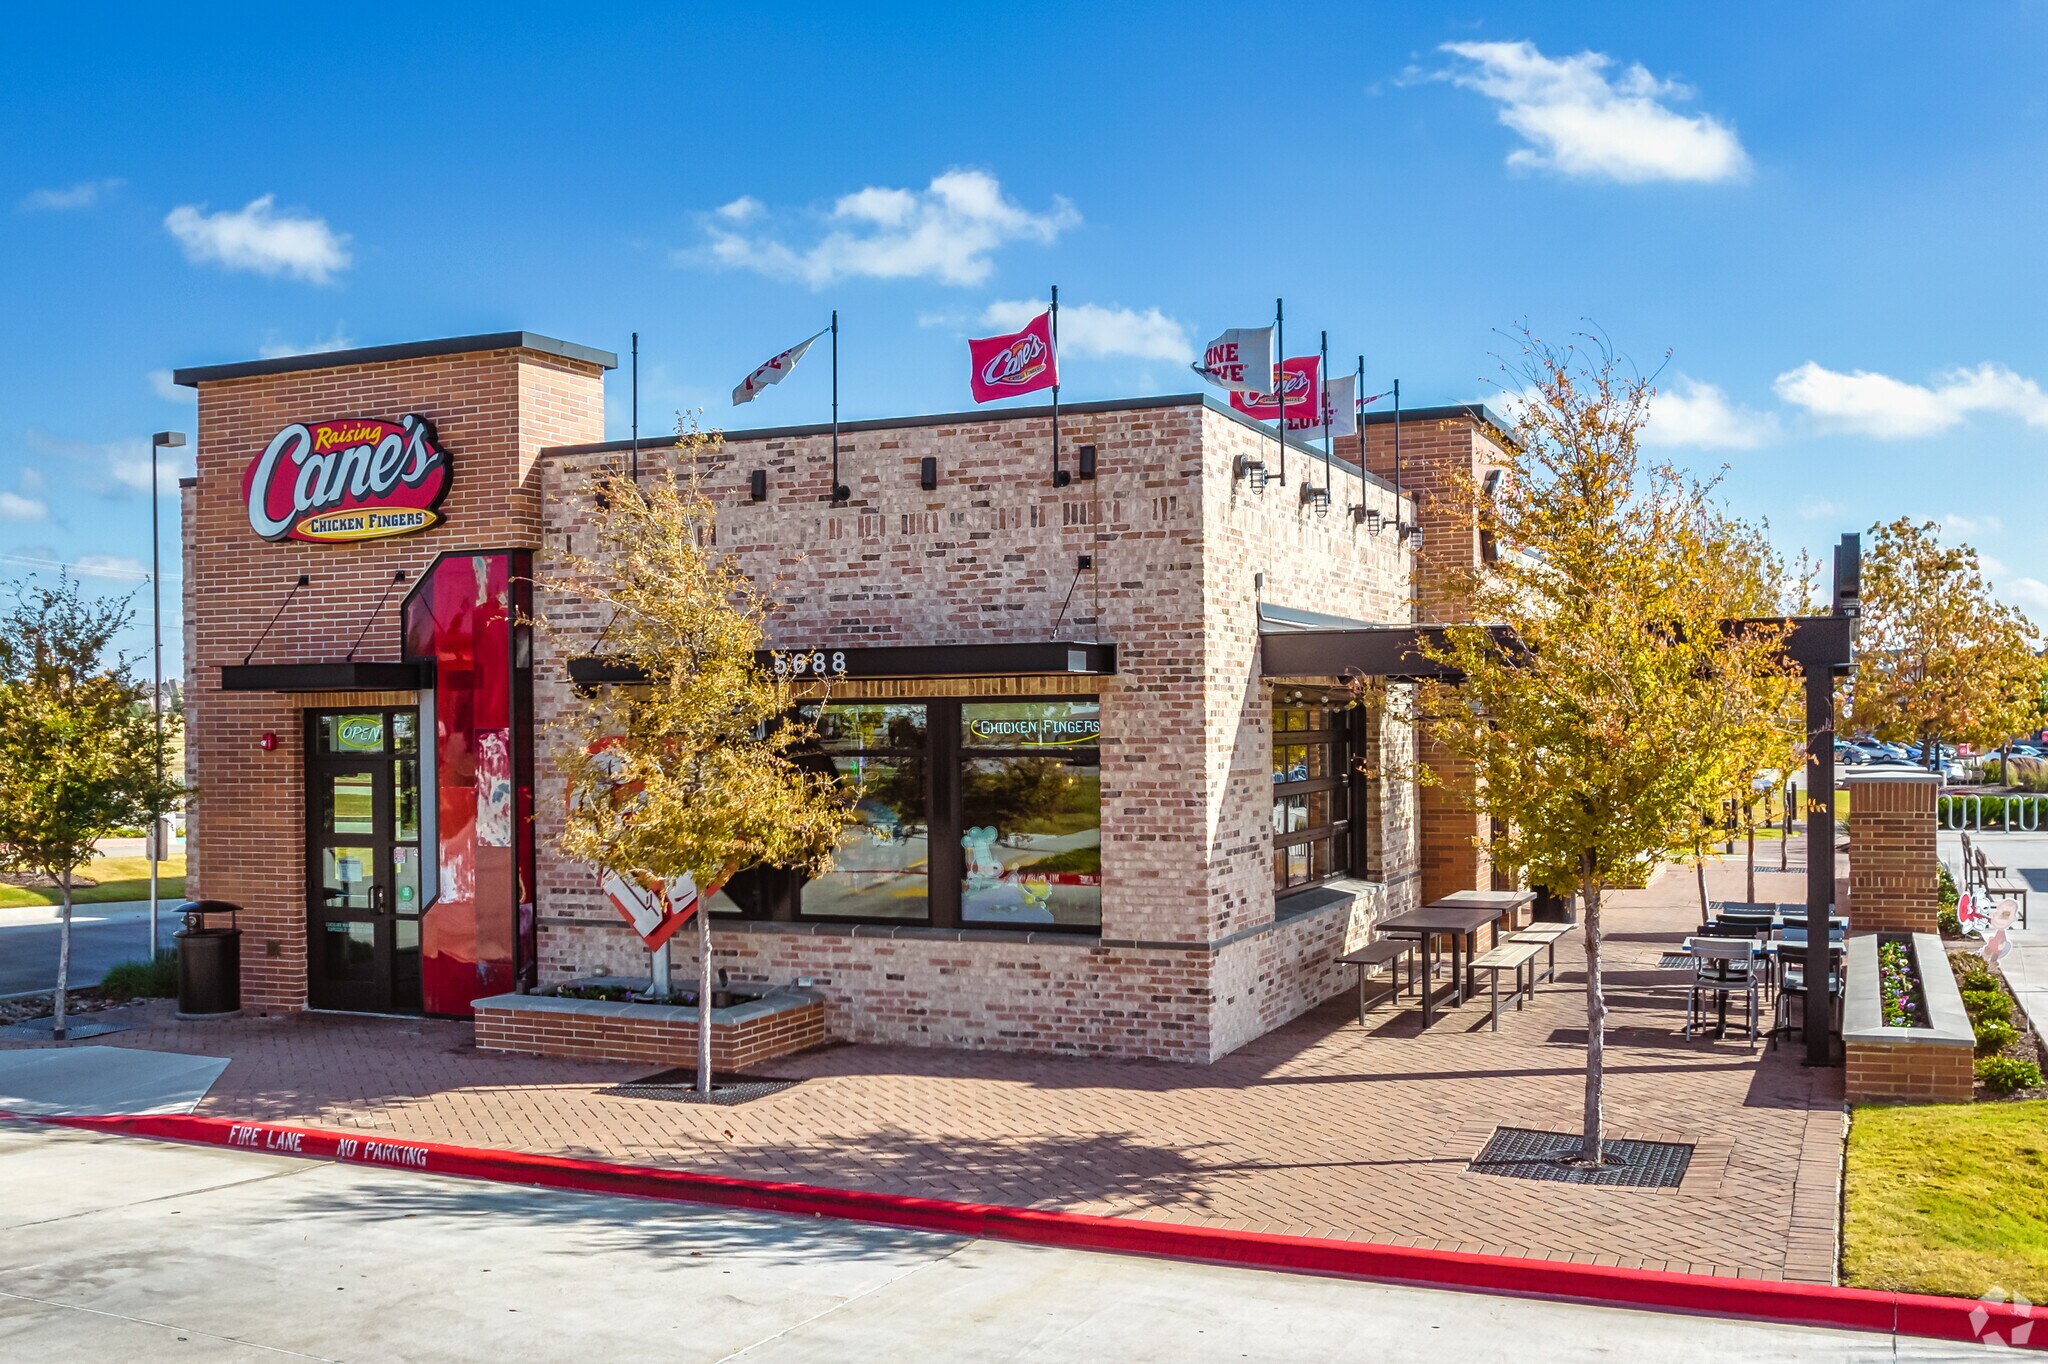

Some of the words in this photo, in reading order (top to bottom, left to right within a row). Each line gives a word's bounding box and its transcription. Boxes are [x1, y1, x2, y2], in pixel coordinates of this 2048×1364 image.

[985, 334, 1044, 384] Cane's
[1206, 343, 1239, 366] ONE
[315, 422, 382, 450] Raising
[248, 414, 441, 538] Cane's
[311, 516, 364, 533] CHICKEN
[368, 512, 423, 529] FINGERS
[774, 651, 846, 675] 5688
[342, 726, 380, 742] OPEN
[980, 720, 1038, 734] CHICKEN
[1043, 719, 1100, 733] FINGERS
[228, 1125, 262, 1147] FIRE
[266, 1130, 305, 1152] LANE
[337, 1138, 358, 1158] NO
[364, 1142, 429, 1167] PARKING
